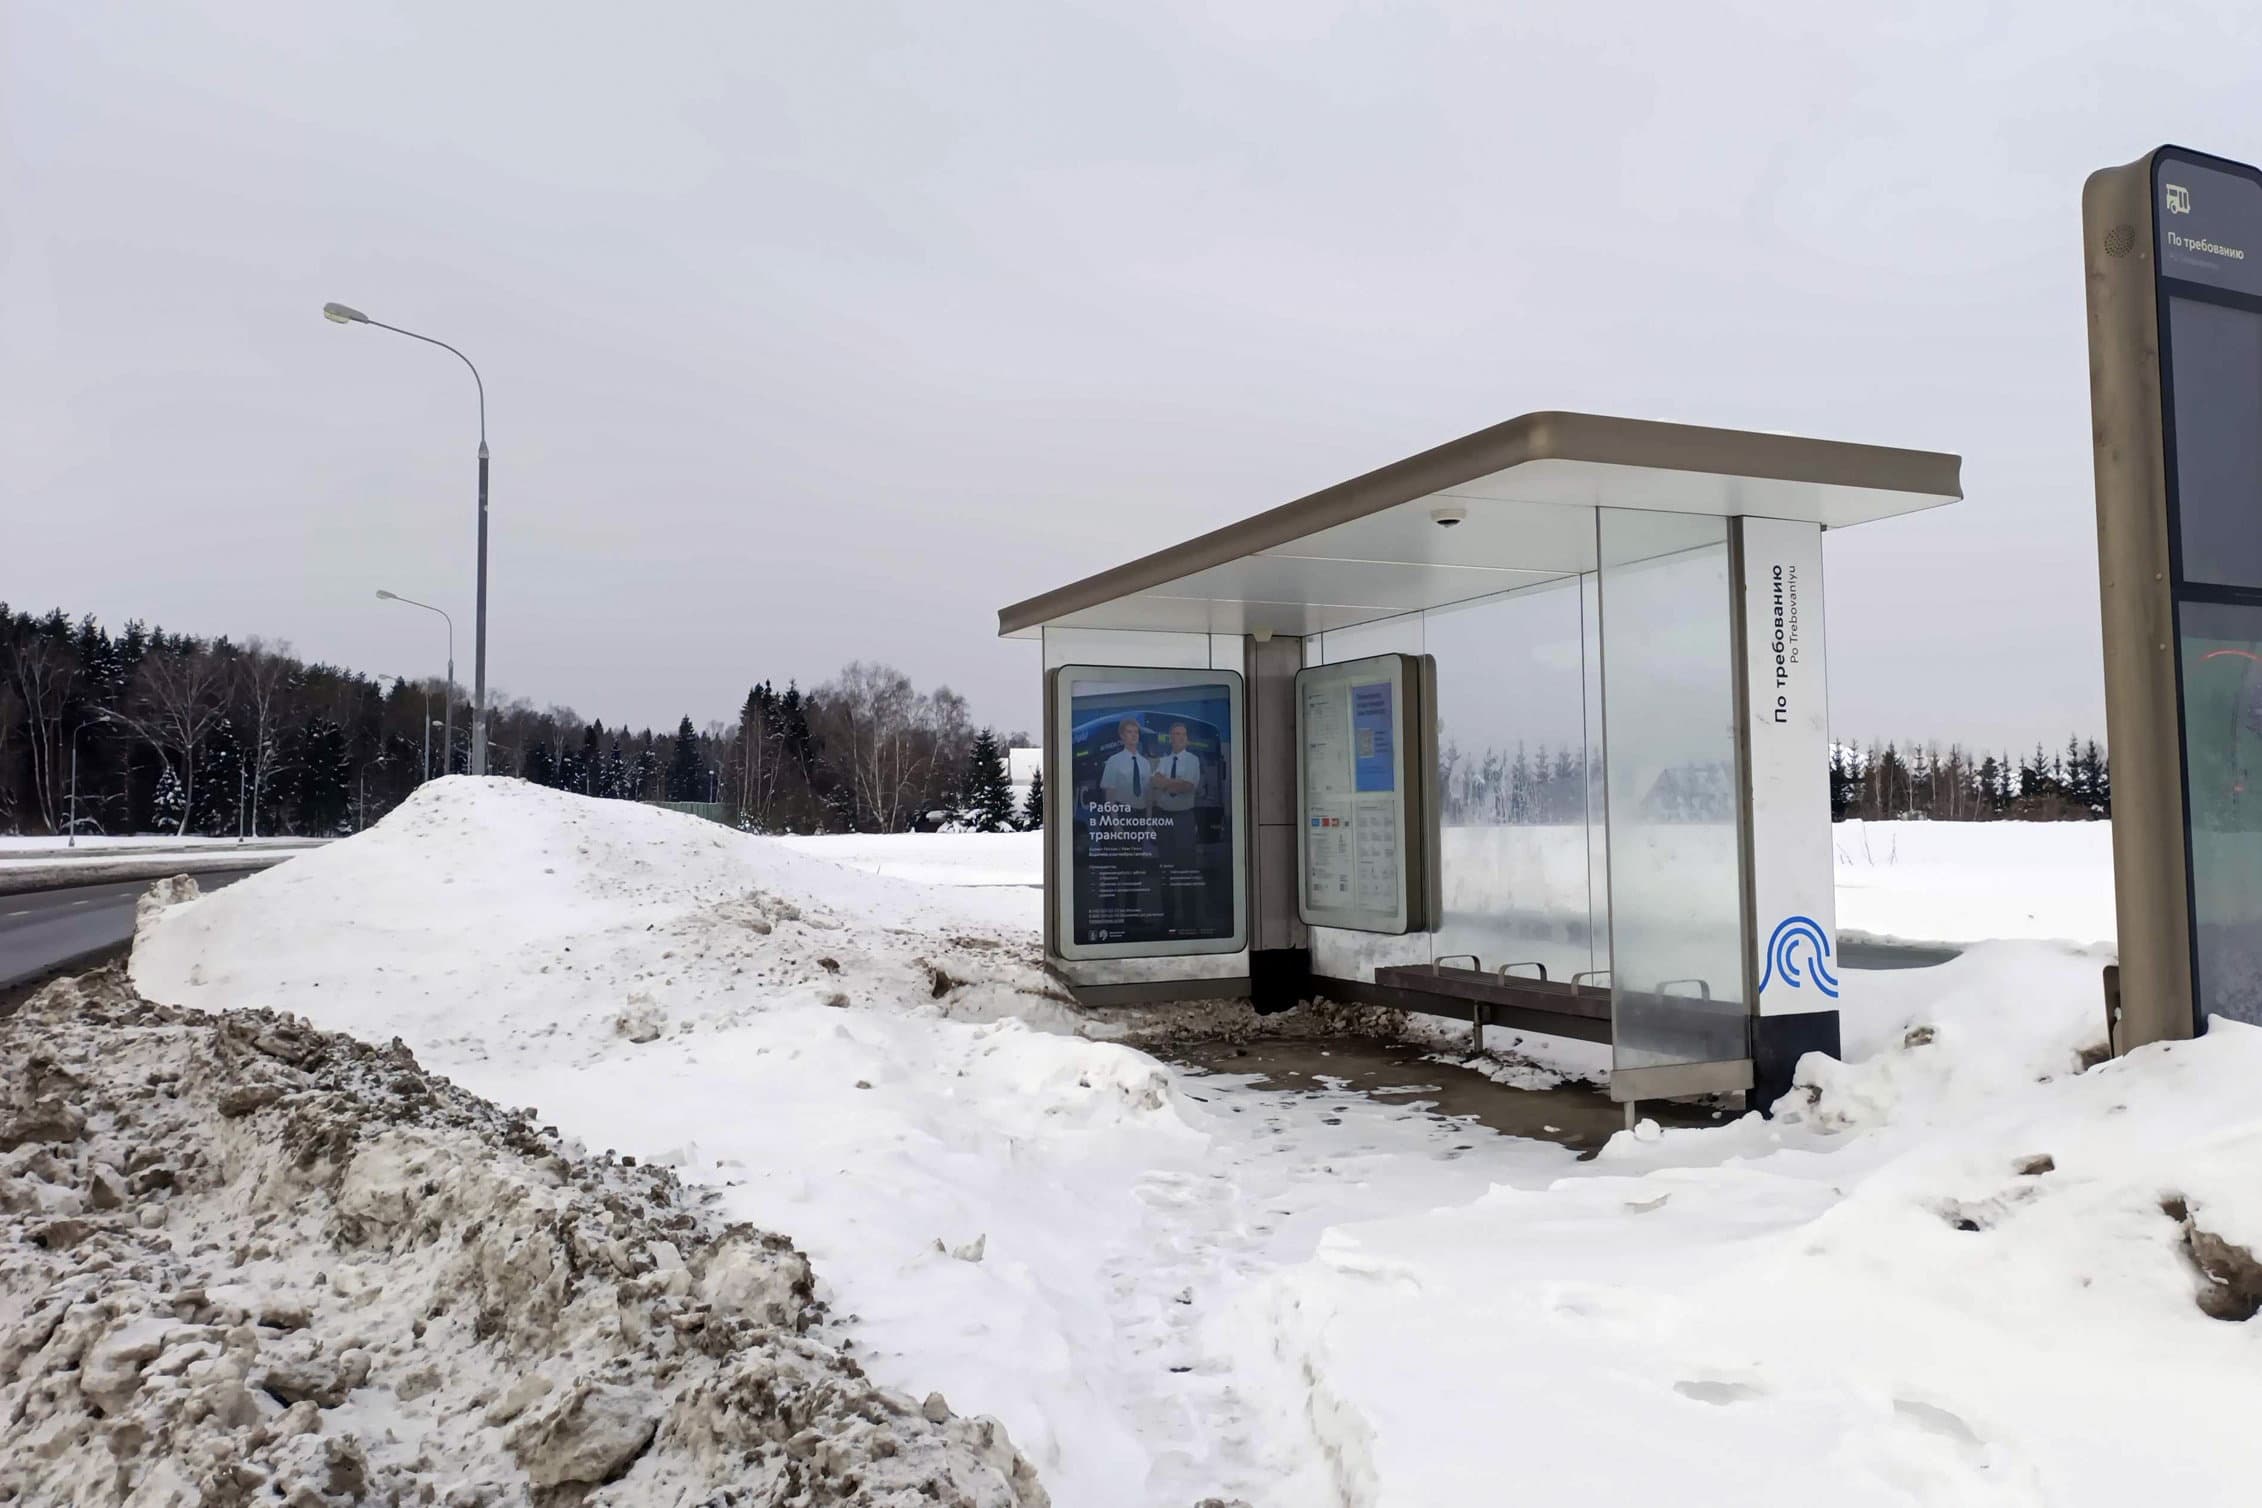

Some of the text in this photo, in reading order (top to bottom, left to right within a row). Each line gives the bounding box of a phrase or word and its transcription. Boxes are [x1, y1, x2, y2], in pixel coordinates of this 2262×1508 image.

[2167, 231, 2245, 260] По требованию
[1787, 565, 1799, 664] Po Trebovaniyu
[1771, 564, 1788, 723] По требованию
[1089, 801, 1132, 813] Работа
[1089, 815, 1174, 826] в Московском
[1089, 831, 1157, 843] транспорте
